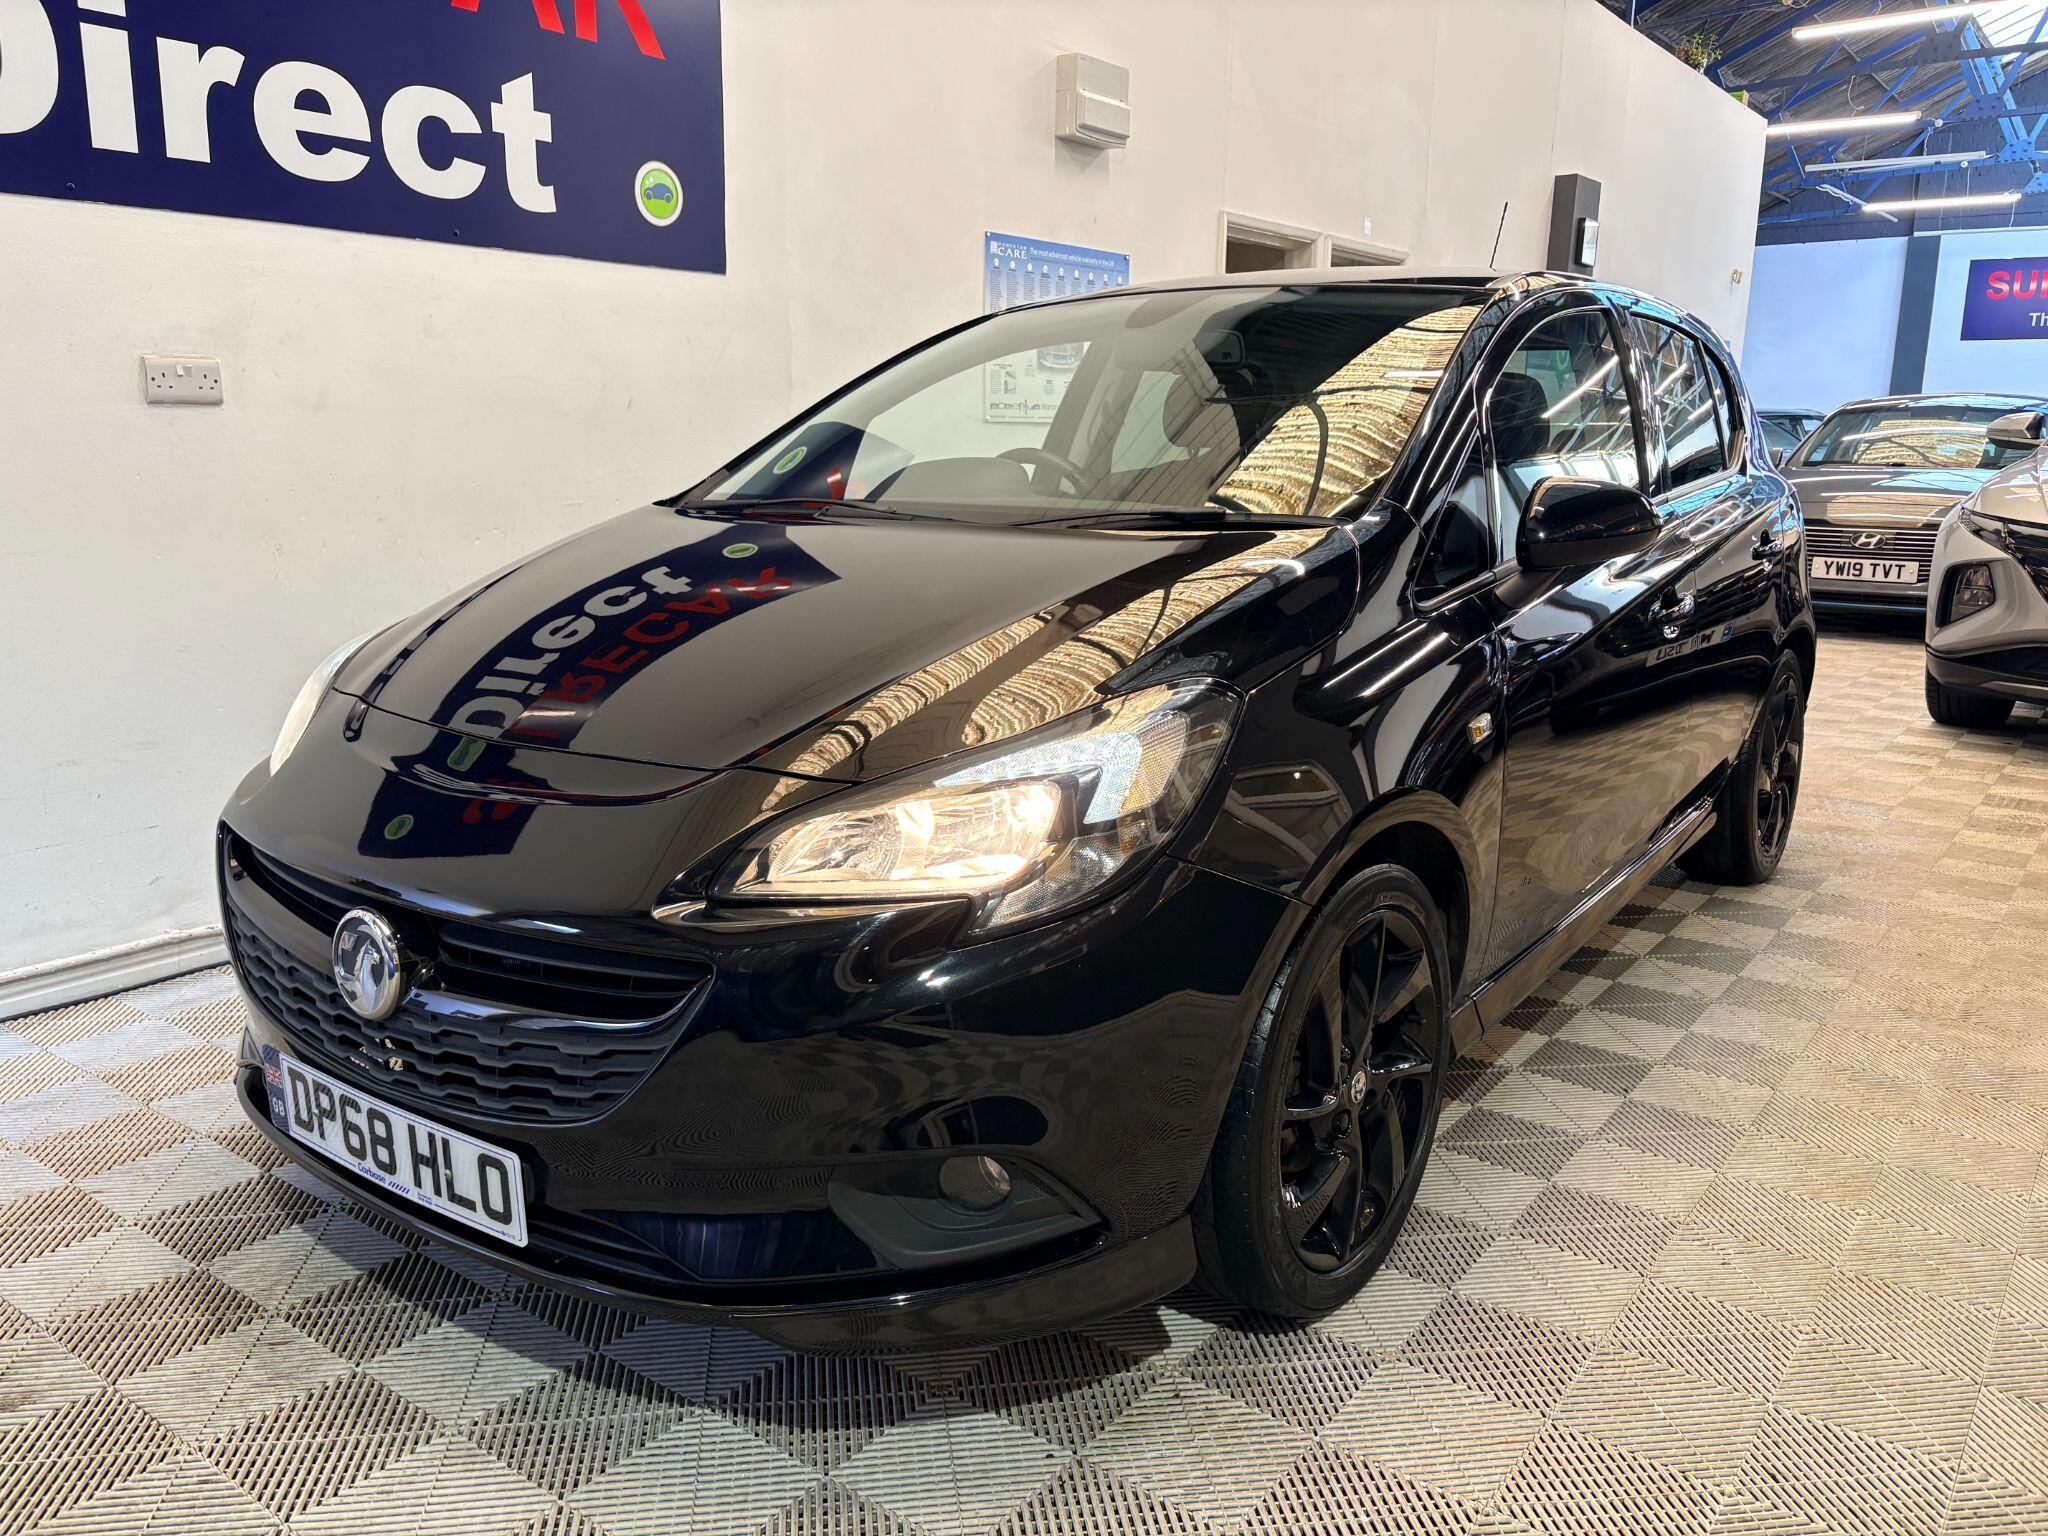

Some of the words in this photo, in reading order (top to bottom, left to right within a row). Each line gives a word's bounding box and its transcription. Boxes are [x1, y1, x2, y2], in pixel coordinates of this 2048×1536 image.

[997, 247, 1028, 260] CARE
[1824, 560, 1863, 577] YW19
[1870, 563, 1906, 579] TVT
[272, 1097, 285, 1117] GB
[288, 1066, 397, 1177] DP68
[407, 1123, 513, 1226] HLO
